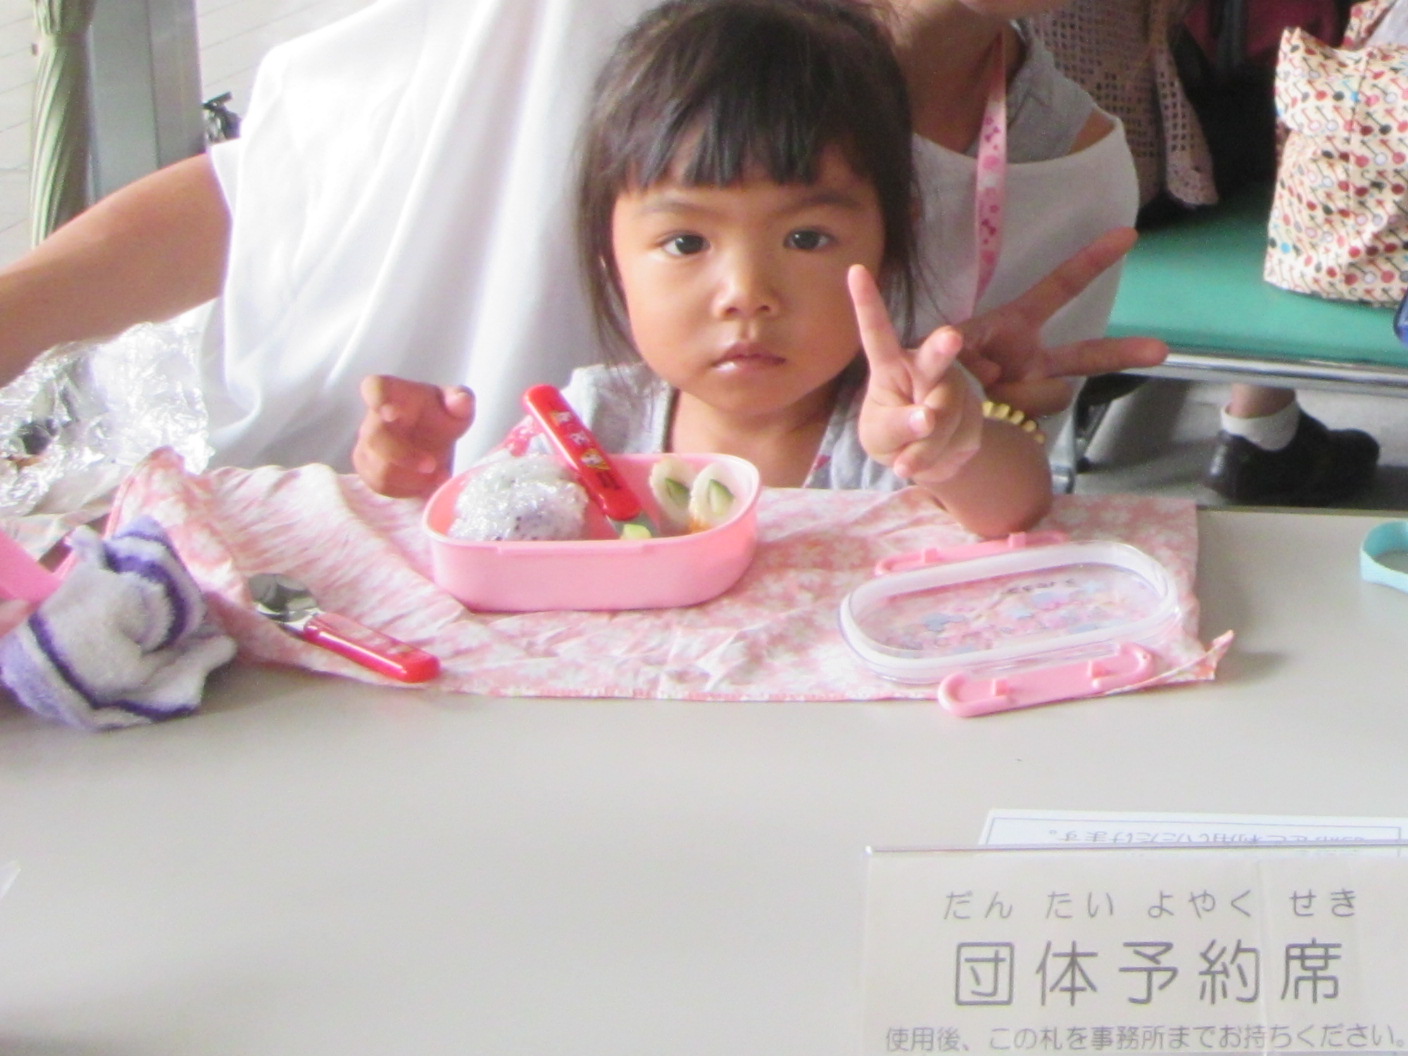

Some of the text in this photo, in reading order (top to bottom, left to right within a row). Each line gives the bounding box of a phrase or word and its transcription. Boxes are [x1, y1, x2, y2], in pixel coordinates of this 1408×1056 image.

[943, 888, 1358, 920] だん たい よやく せき
[954, 938, 1342, 1007] 団体予約席
[885, 1024, 1405, 1052] 使用後、この札を事務所までお持ちください。
